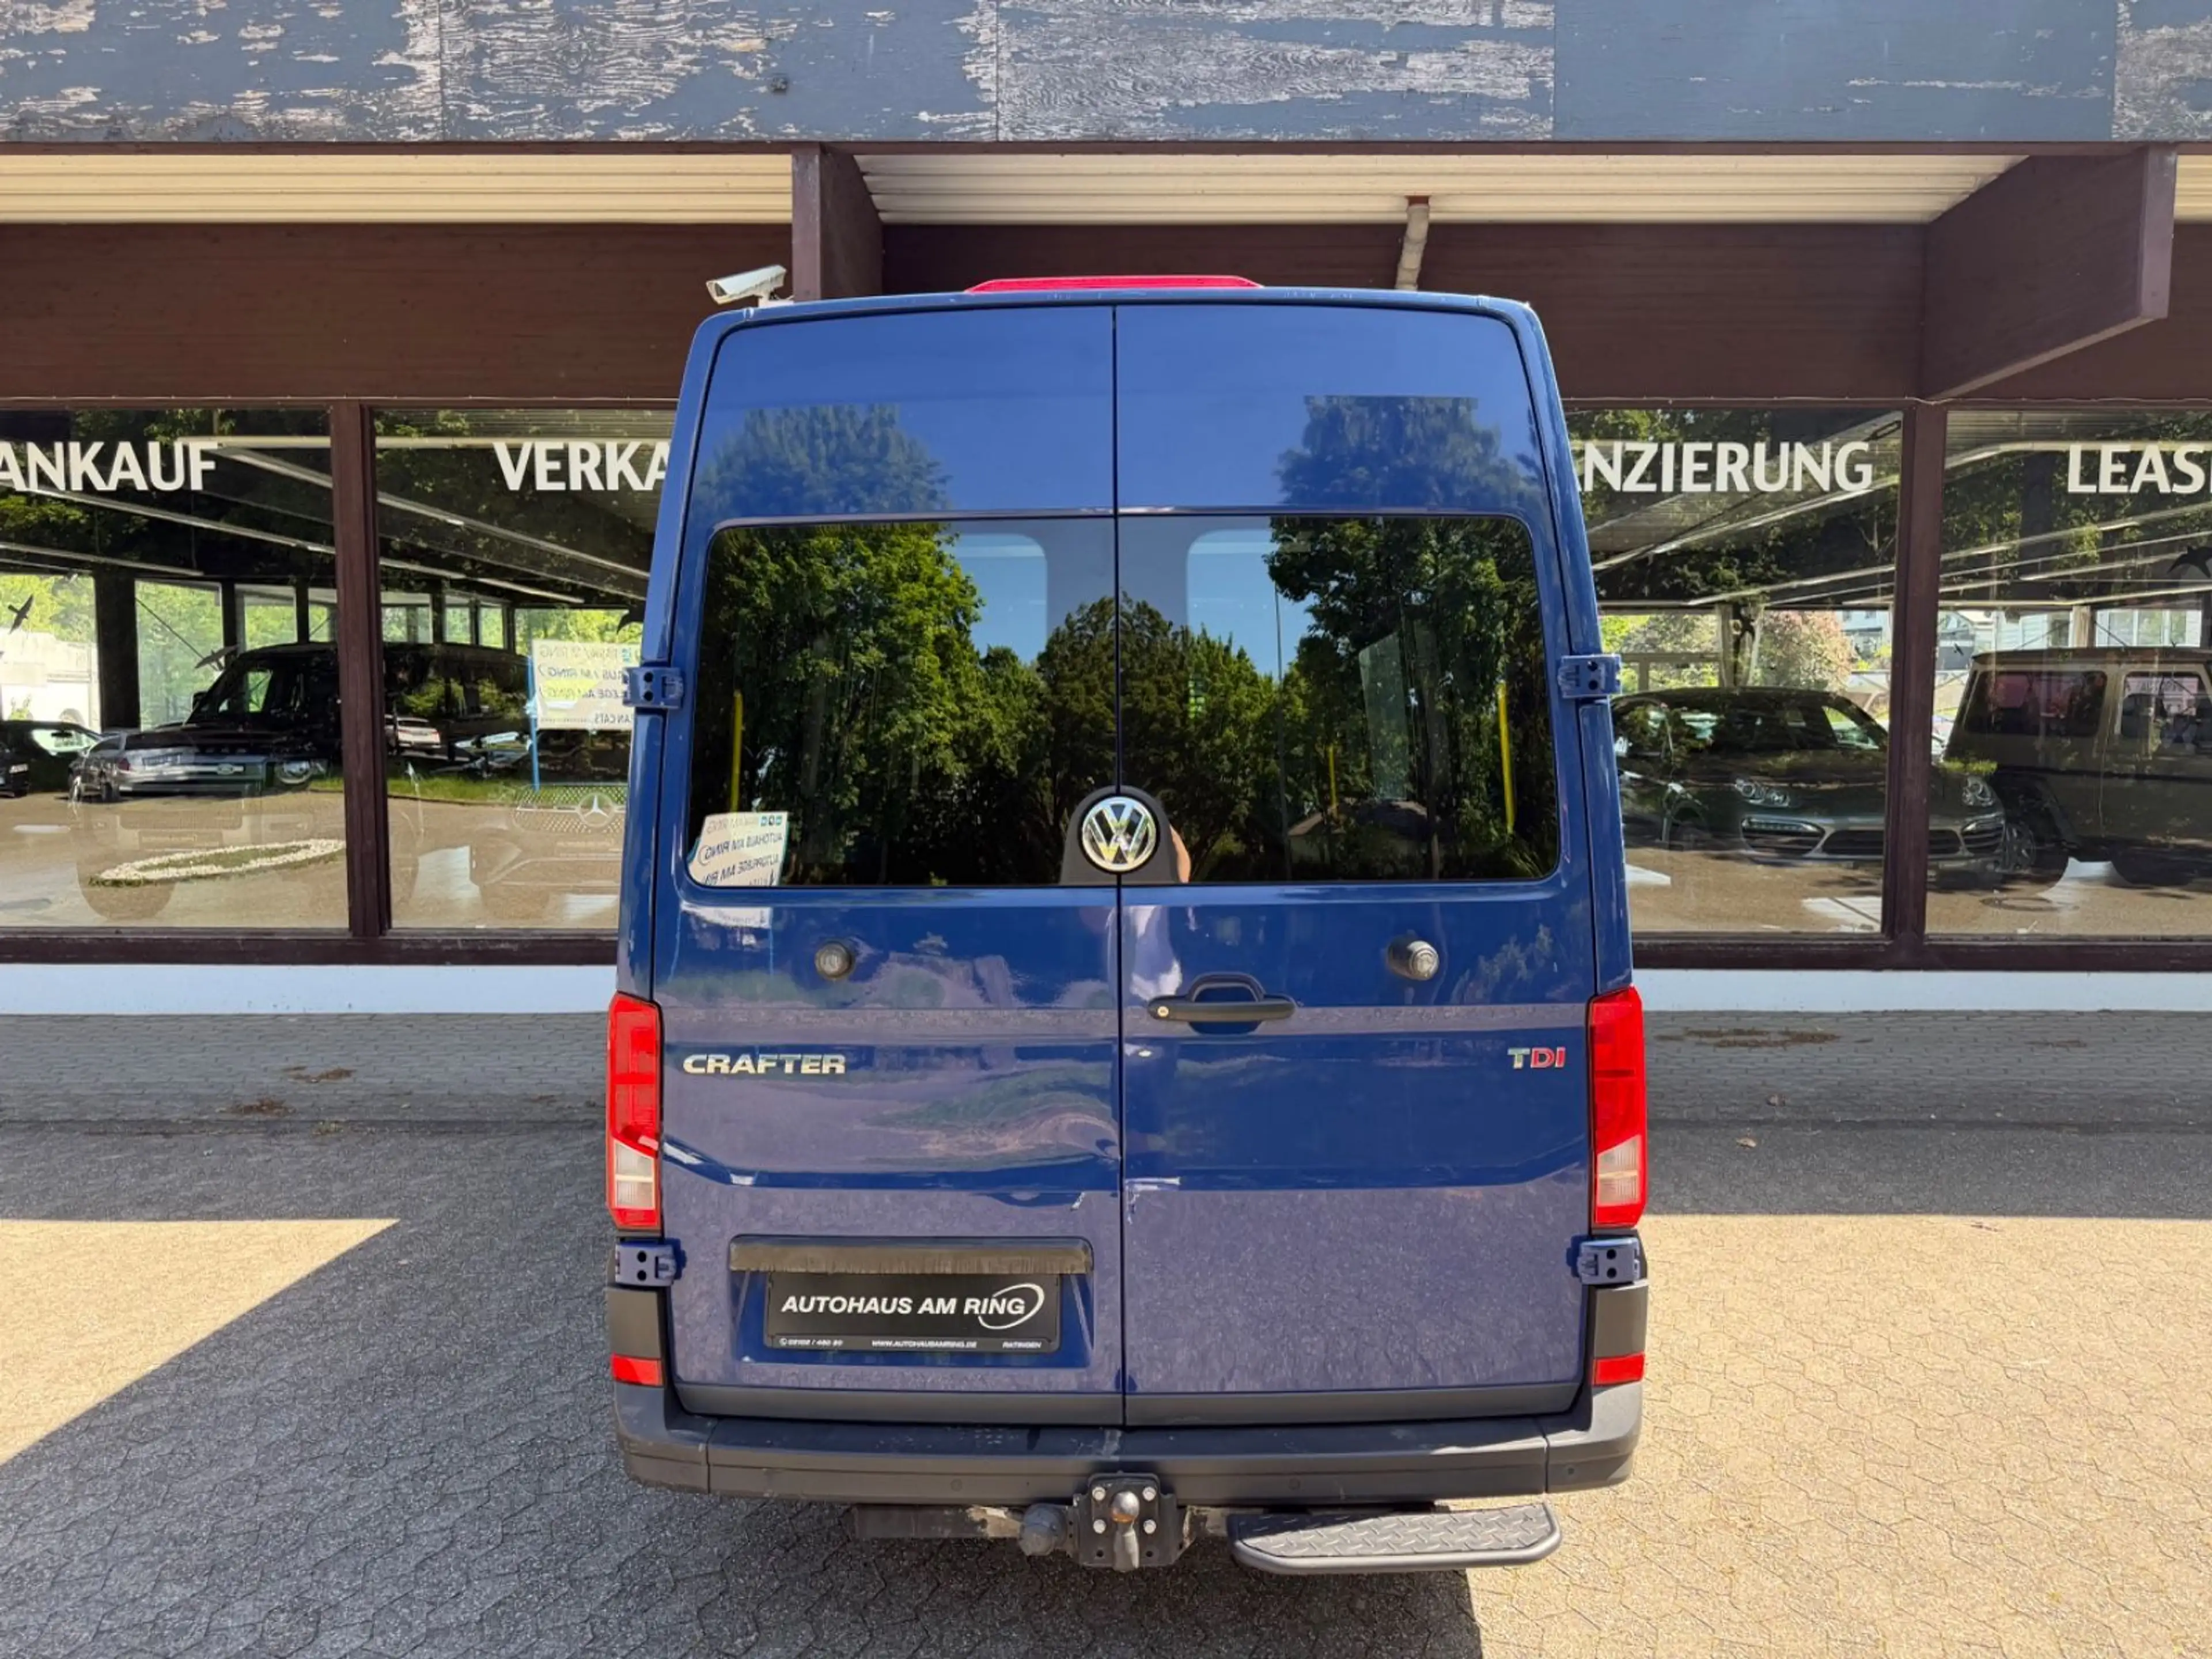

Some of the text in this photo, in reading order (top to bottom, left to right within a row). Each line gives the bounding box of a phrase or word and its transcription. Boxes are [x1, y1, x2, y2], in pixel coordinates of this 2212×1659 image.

[0, 441, 218, 491] ANKAUF
[2067, 443, 2212, 494] LEAS
[683, 1054, 846, 1074] CRAFTER
[1507, 1047, 1566, 1069] TDI
[781, 1296, 1026, 1315] AUTOHAUS AM RING
